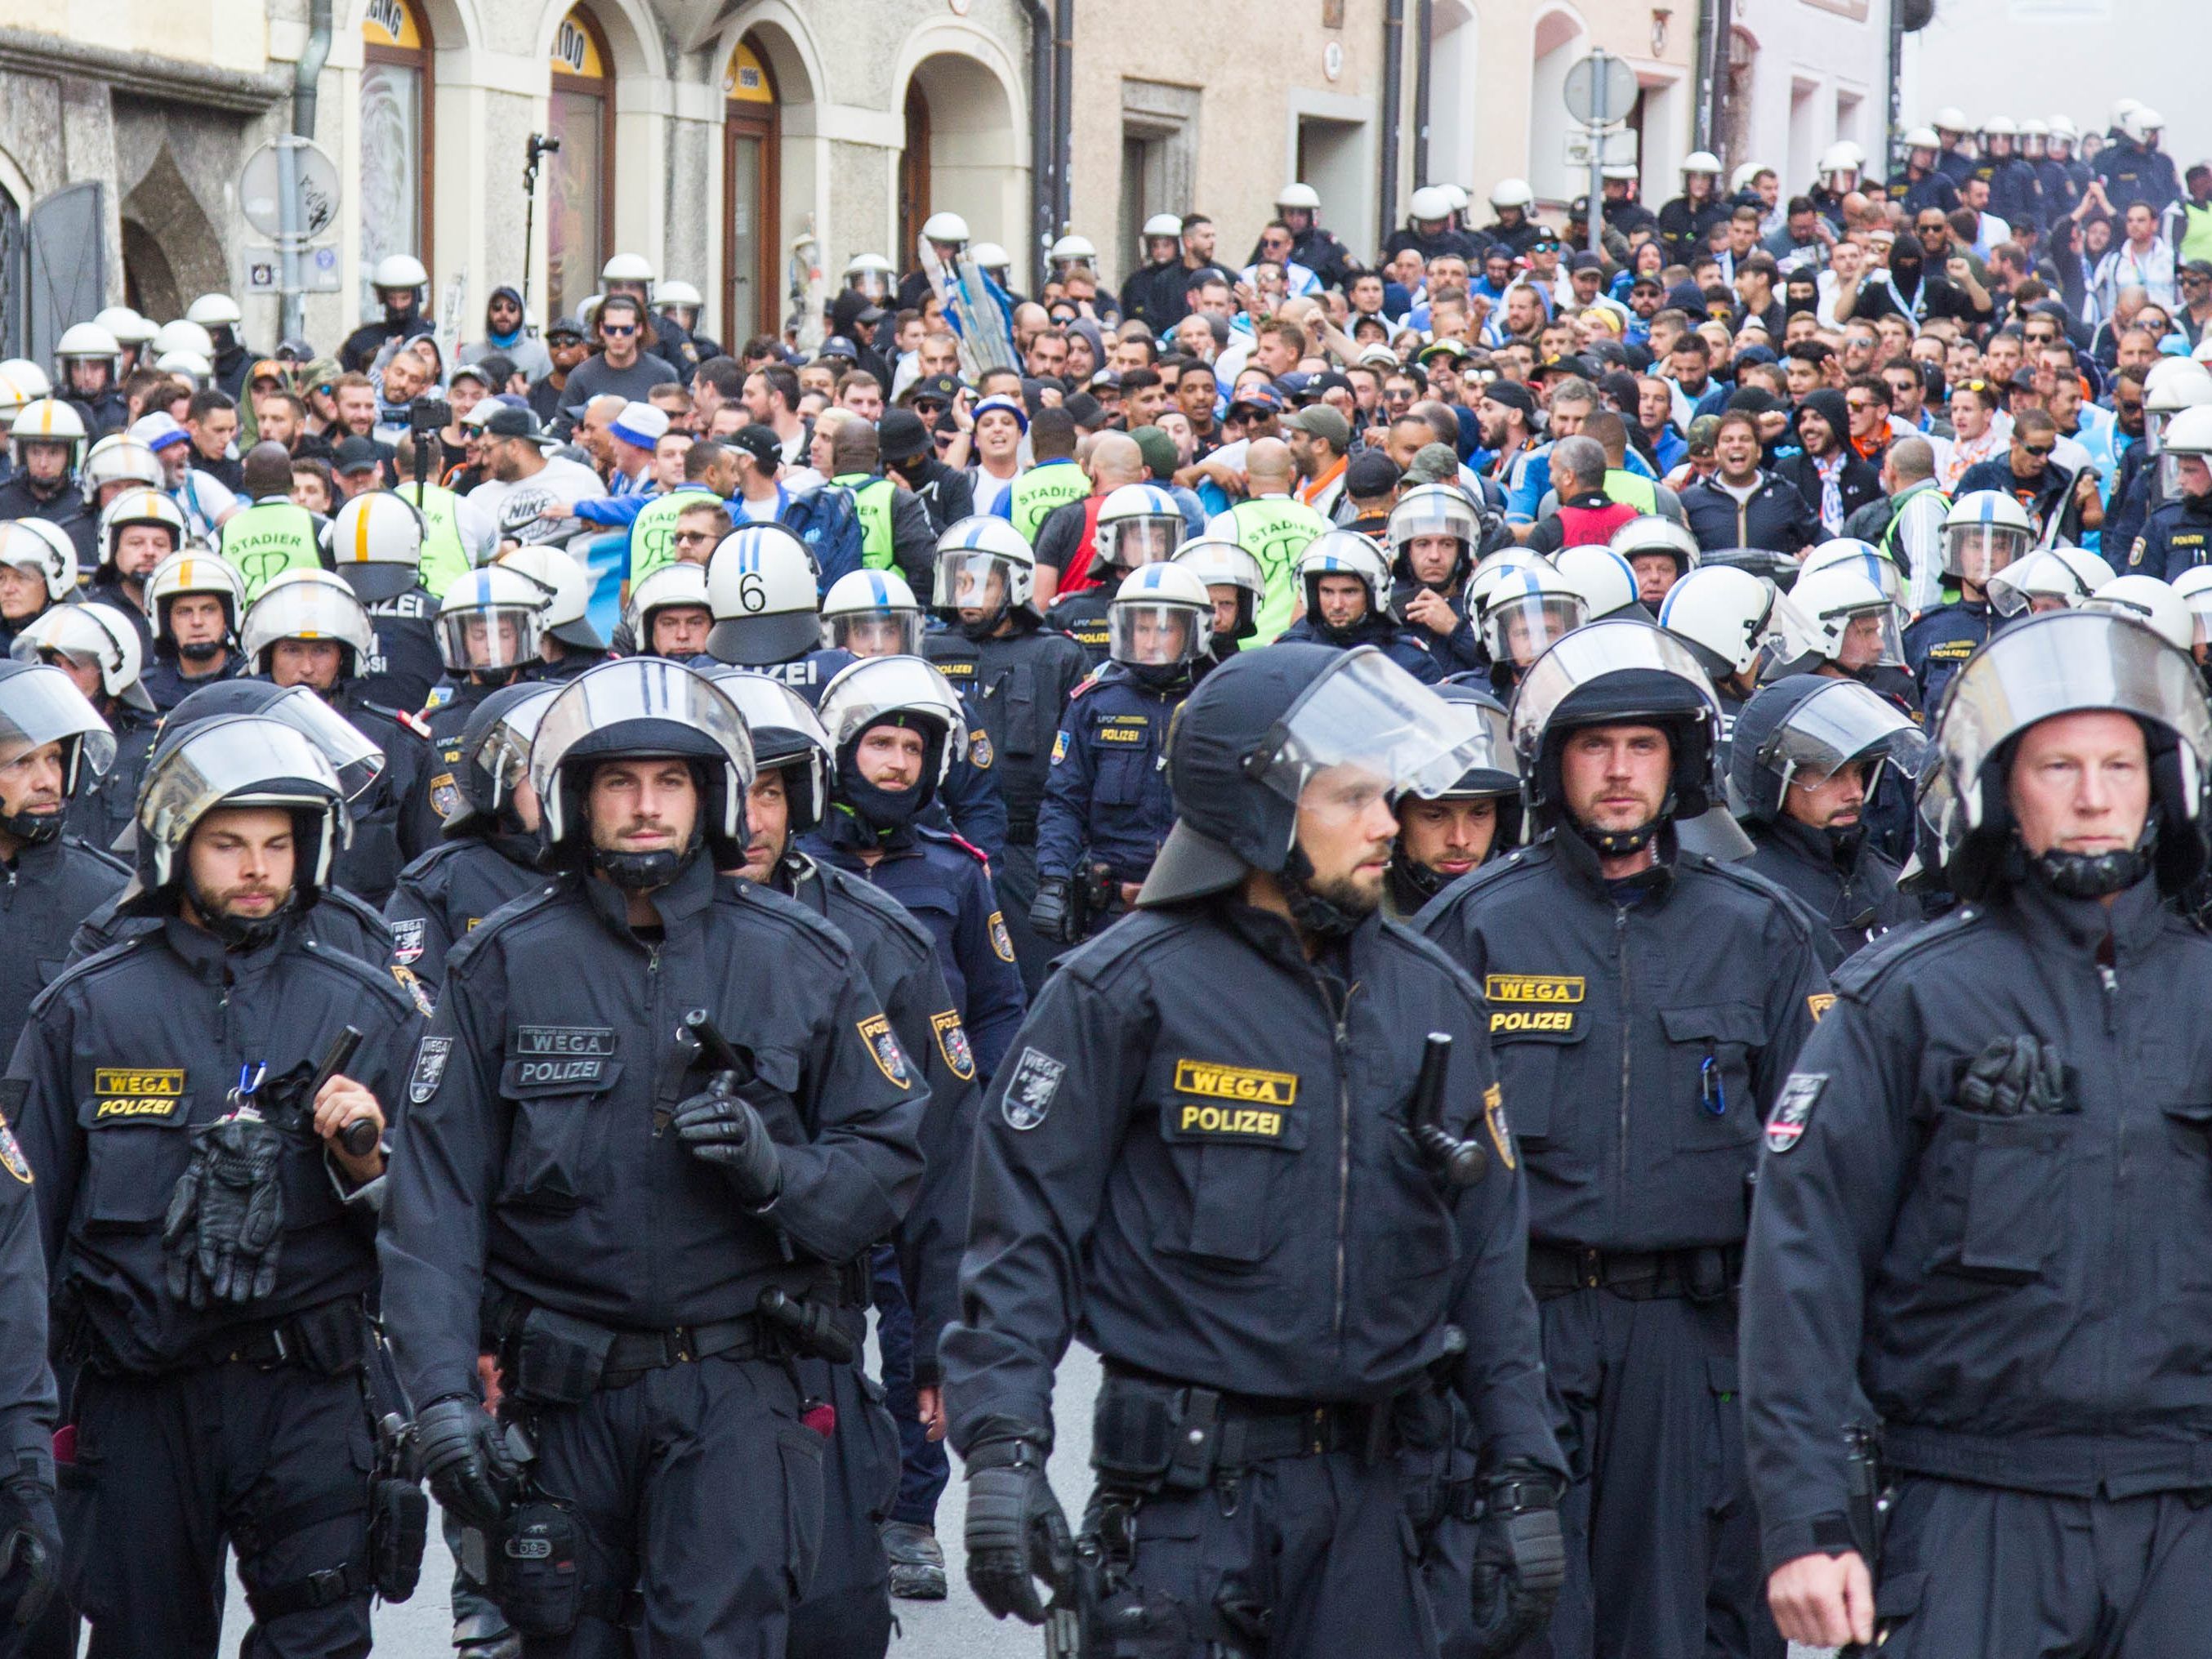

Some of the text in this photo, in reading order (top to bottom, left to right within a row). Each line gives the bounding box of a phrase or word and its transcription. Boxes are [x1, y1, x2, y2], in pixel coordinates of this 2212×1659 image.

[365, 0, 402, 38] CING
[551, 20, 584, 70] TOO
[638, 512, 678, 530] STAD
[1248, 520, 1319, 543] STADIER
[229, 533, 301, 555] STADIER
[740, 573, 765, 613] 6
[368, 593, 424, 618] IZEI
[1100, 729, 1139, 742] POLIZEI
[1501, 983, 1570, 1000] WEGA
[1490, 1012, 1574, 1032] POLIZEI
[423, 1040, 448, 1053] WEGA
[532, 1035, 601, 1052] WEGA
[520, 1061, 602, 1082] POLIZEI
[1023, 1051, 1060, 1079] WEGA
[109, 1077, 172, 1092] WEGA
[1193, 1071, 1278, 1101] WEGA
[96, 1099, 176, 1118] POLIZEI
[1181, 1105, 1282, 1135] POLIZEI
